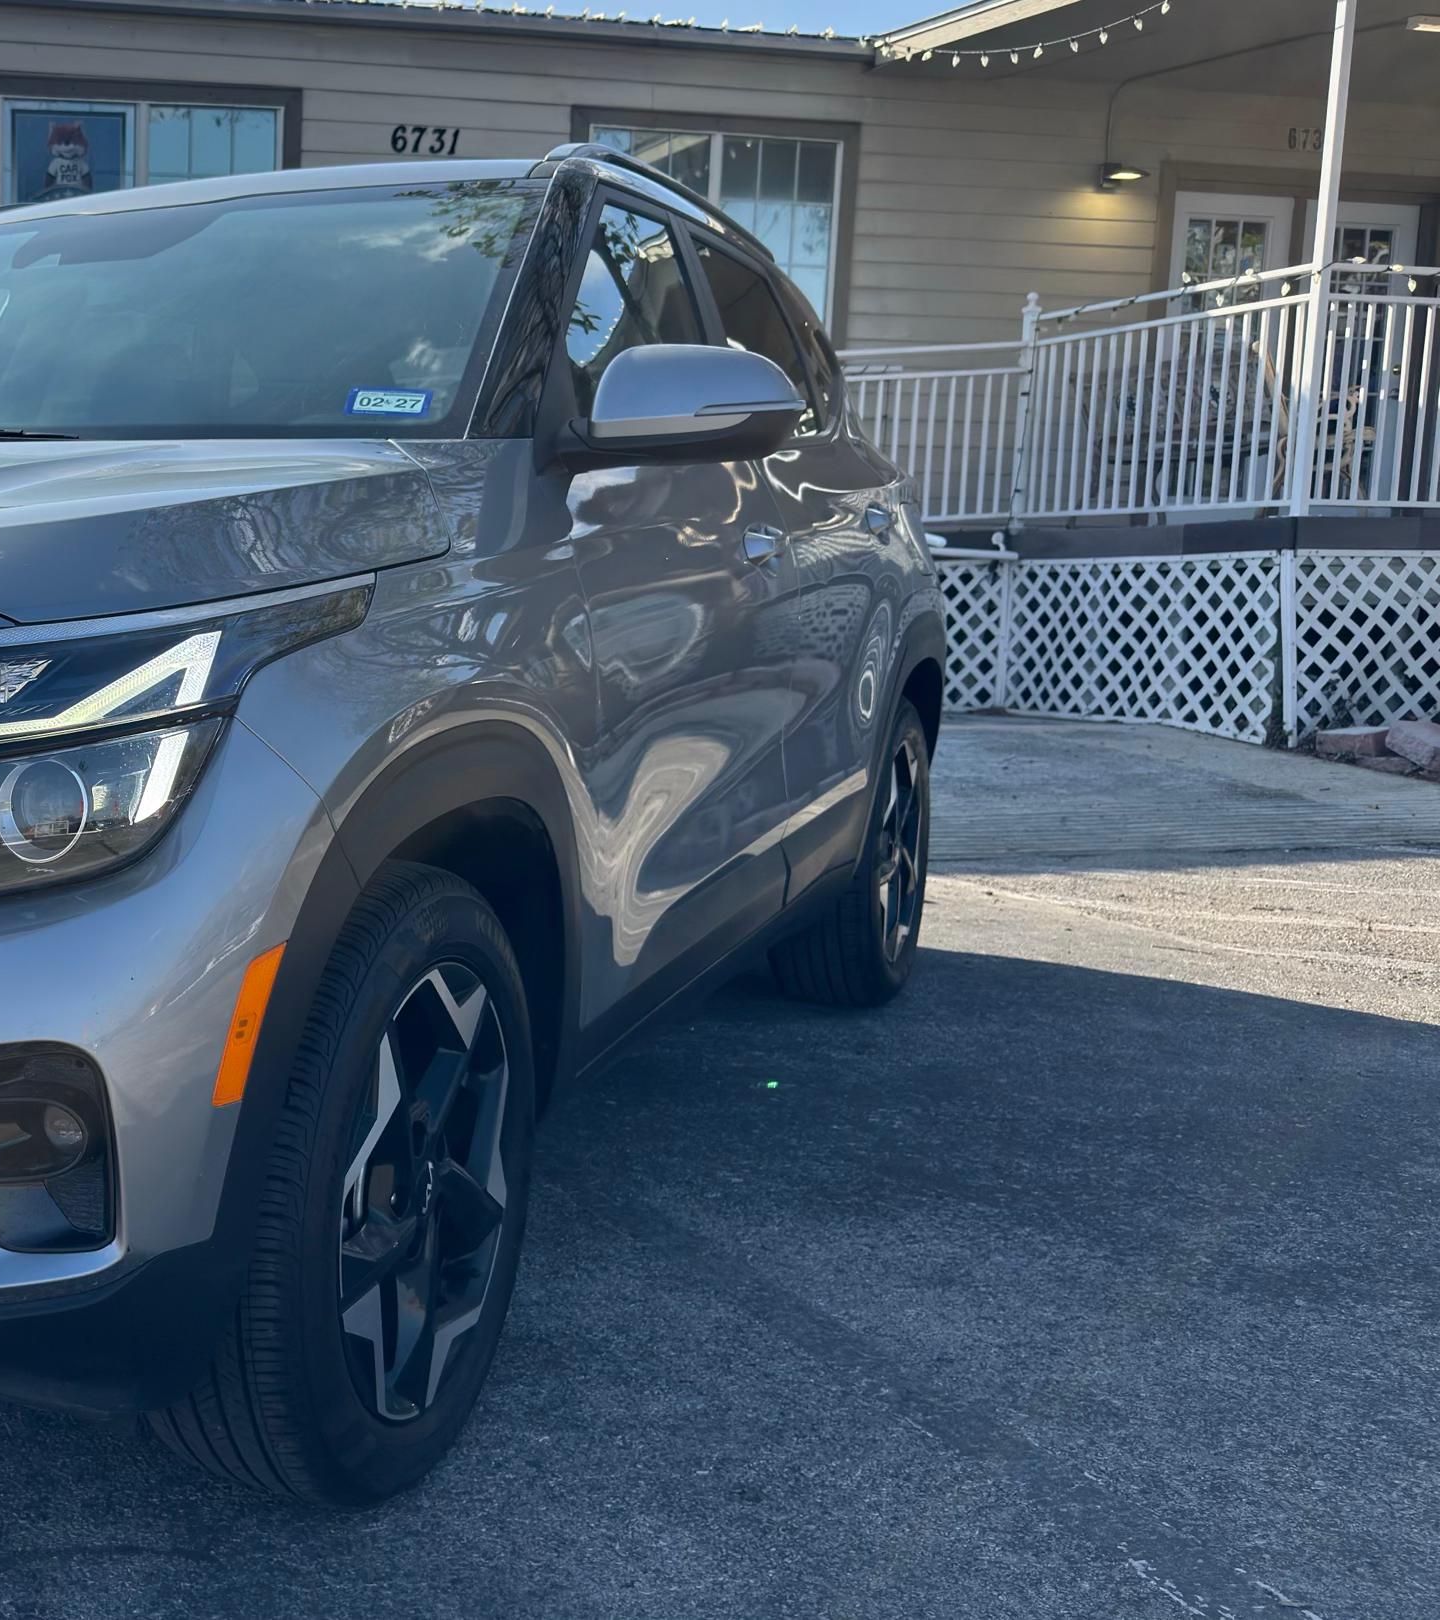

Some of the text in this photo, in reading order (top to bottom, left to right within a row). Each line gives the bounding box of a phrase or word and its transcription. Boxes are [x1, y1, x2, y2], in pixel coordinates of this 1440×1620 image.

[391, 124, 460, 155] 6731
[359, 396, 422, 409] 02 27
